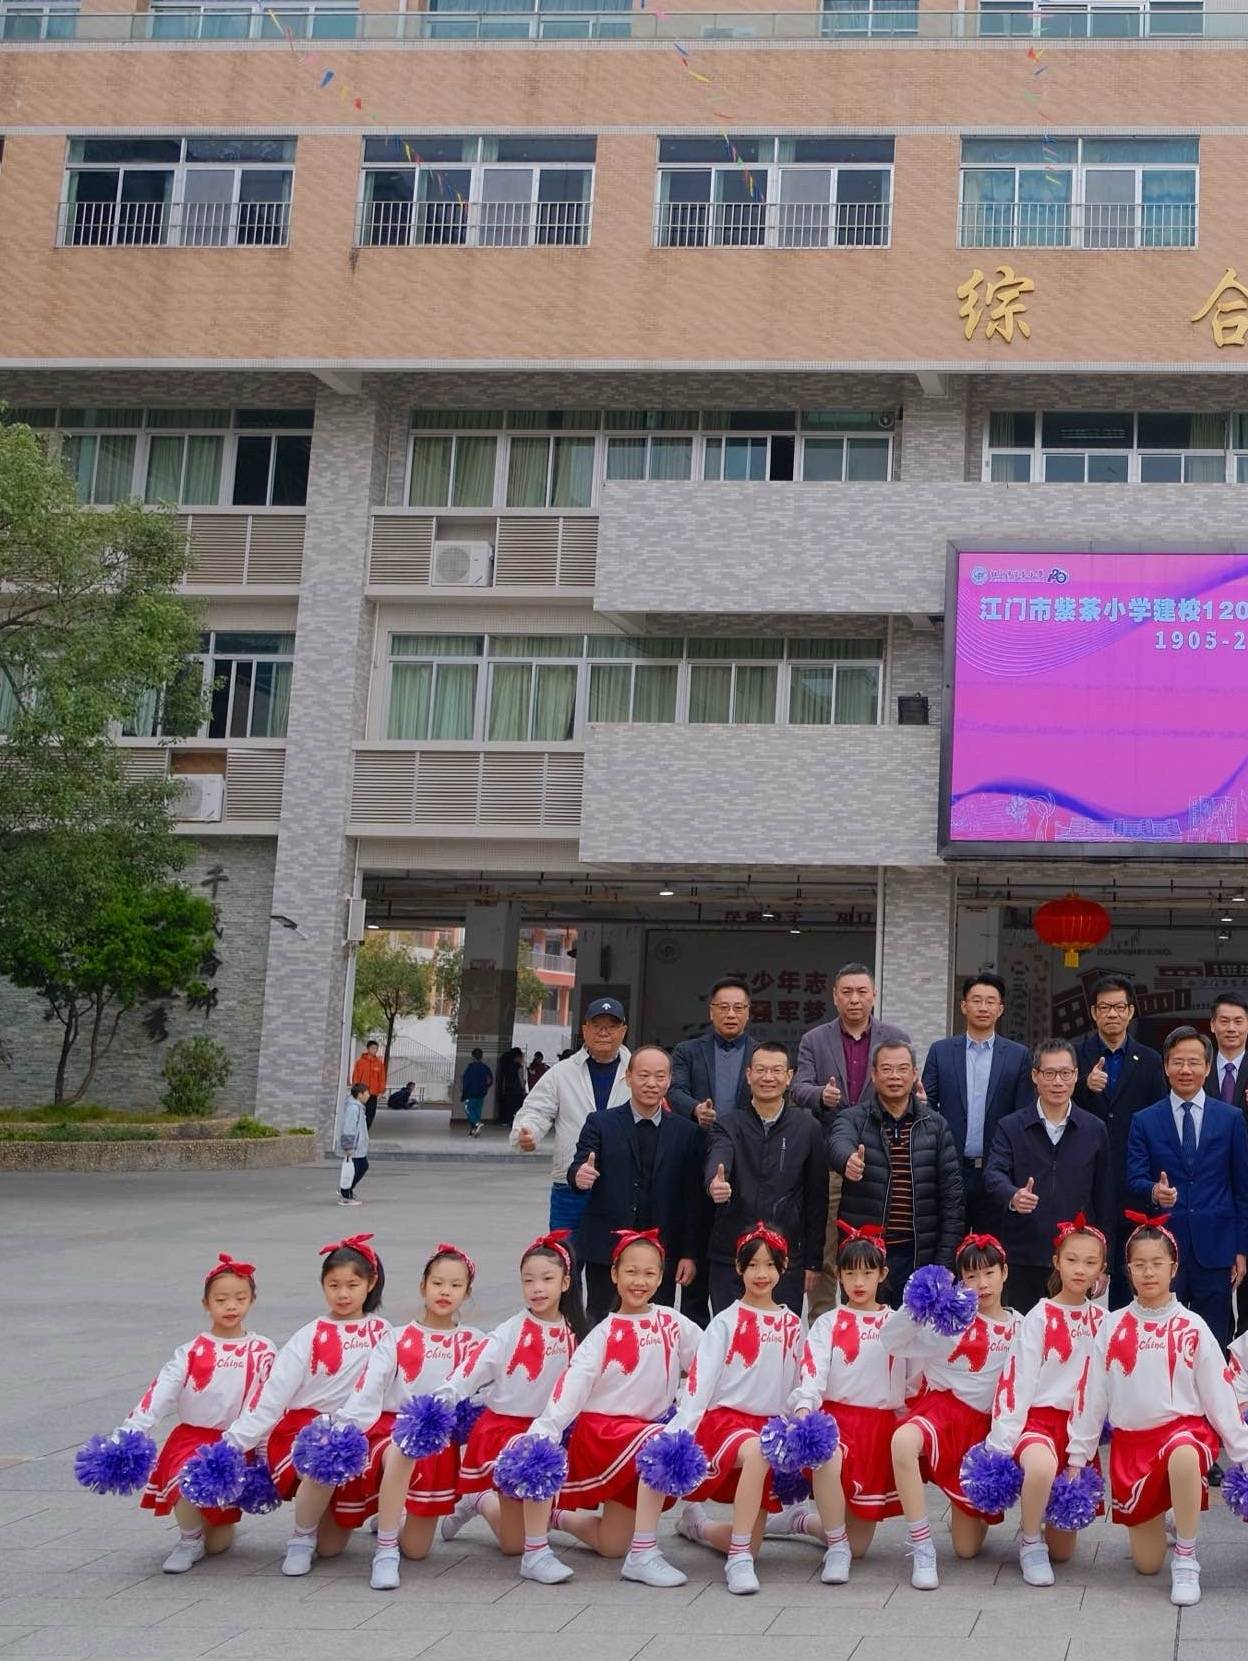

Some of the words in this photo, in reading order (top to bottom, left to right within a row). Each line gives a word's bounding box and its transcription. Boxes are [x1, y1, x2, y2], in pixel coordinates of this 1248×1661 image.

[726, 969, 829, 995] 少年志
[861, 1330, 880, 1341] Chin
[1139, 1337, 1166, 1351] China
